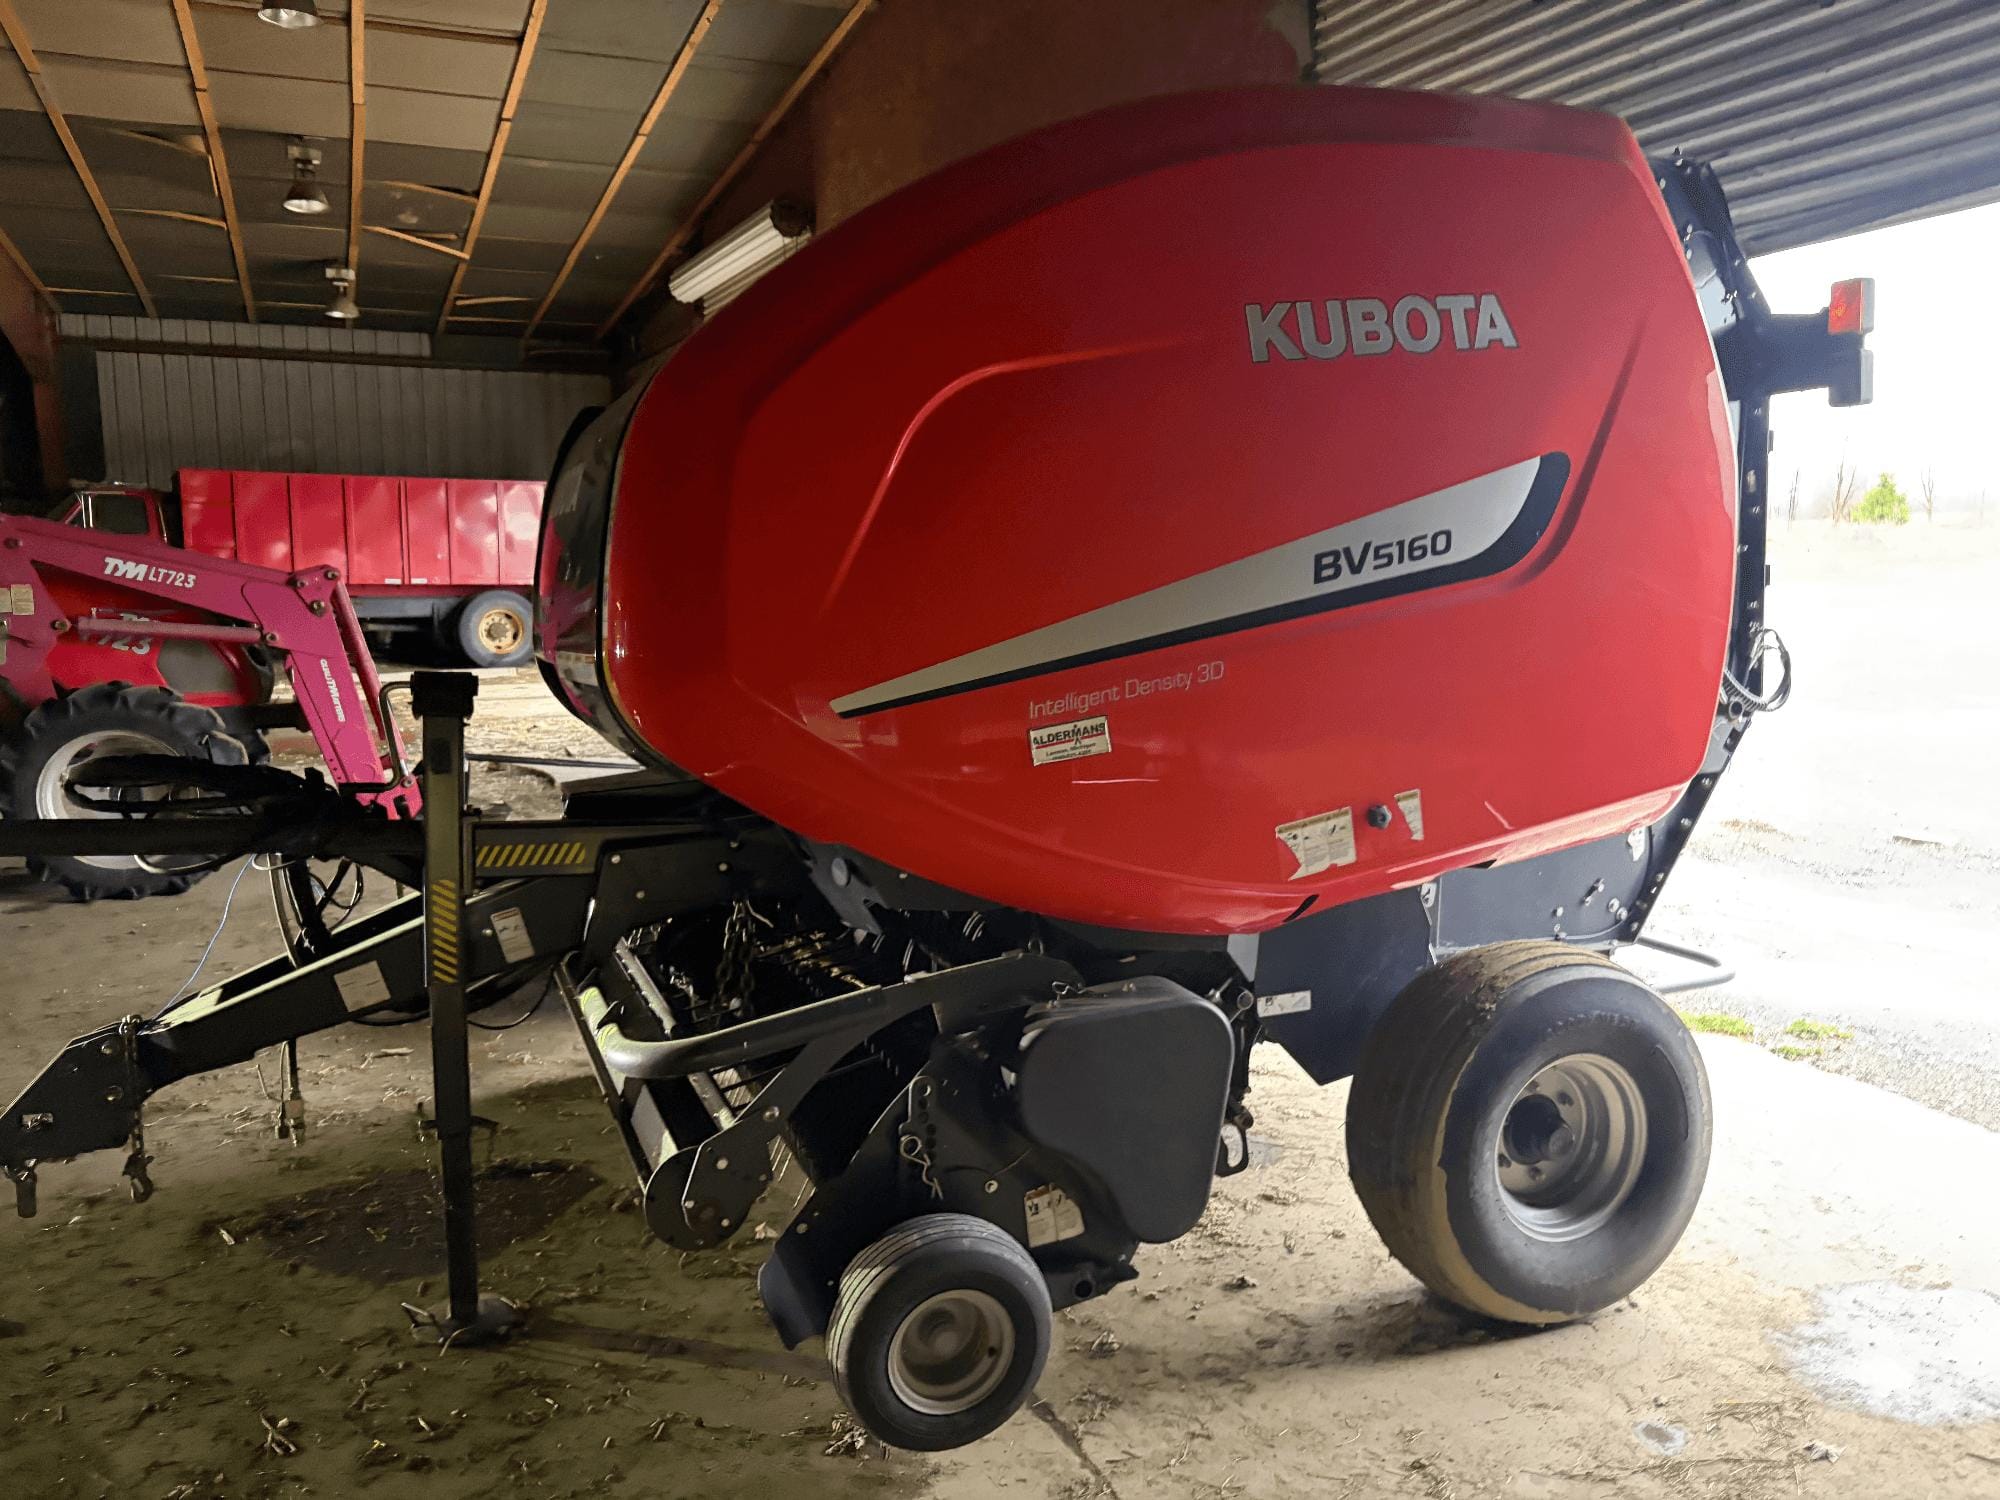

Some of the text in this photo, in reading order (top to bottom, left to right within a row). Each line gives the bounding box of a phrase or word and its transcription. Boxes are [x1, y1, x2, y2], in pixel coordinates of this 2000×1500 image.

[1245, 294, 1519, 363] KUBOTA
[104, 557, 196, 588] TYM LT723
[1313, 529, 1452, 584] BV5160
[1029, 660, 1225, 719] Intelligent Density 3D
[1032, 722, 1106, 745] ALDERMANS
